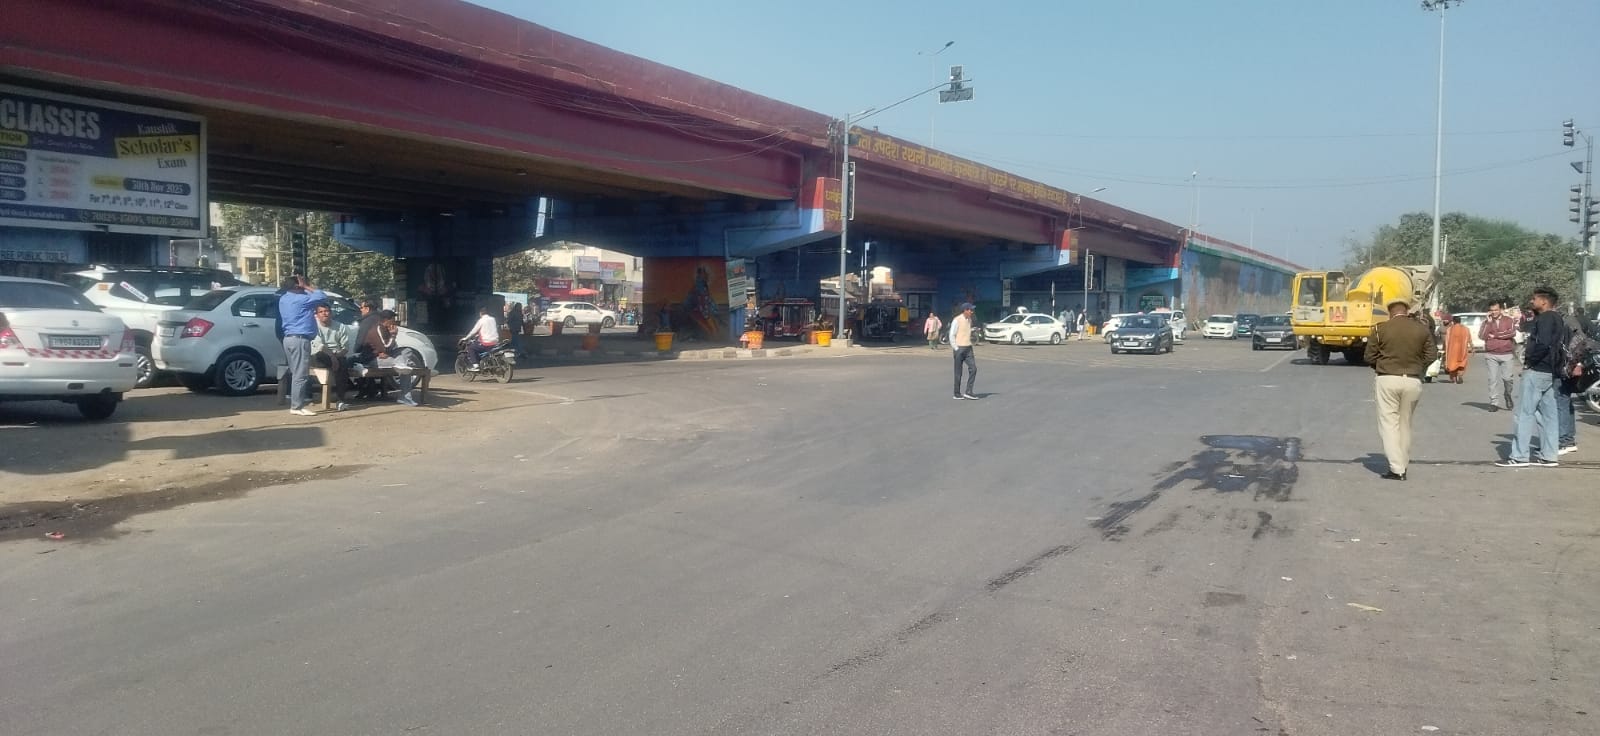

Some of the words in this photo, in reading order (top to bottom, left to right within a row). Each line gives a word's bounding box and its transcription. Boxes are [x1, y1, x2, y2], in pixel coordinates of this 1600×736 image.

[1, 99, 100, 140] CLASSES
[119, 138, 192, 155] Scholar's
[157, 158, 187, 169] Exam
[166, 183, 183, 194] 2025
